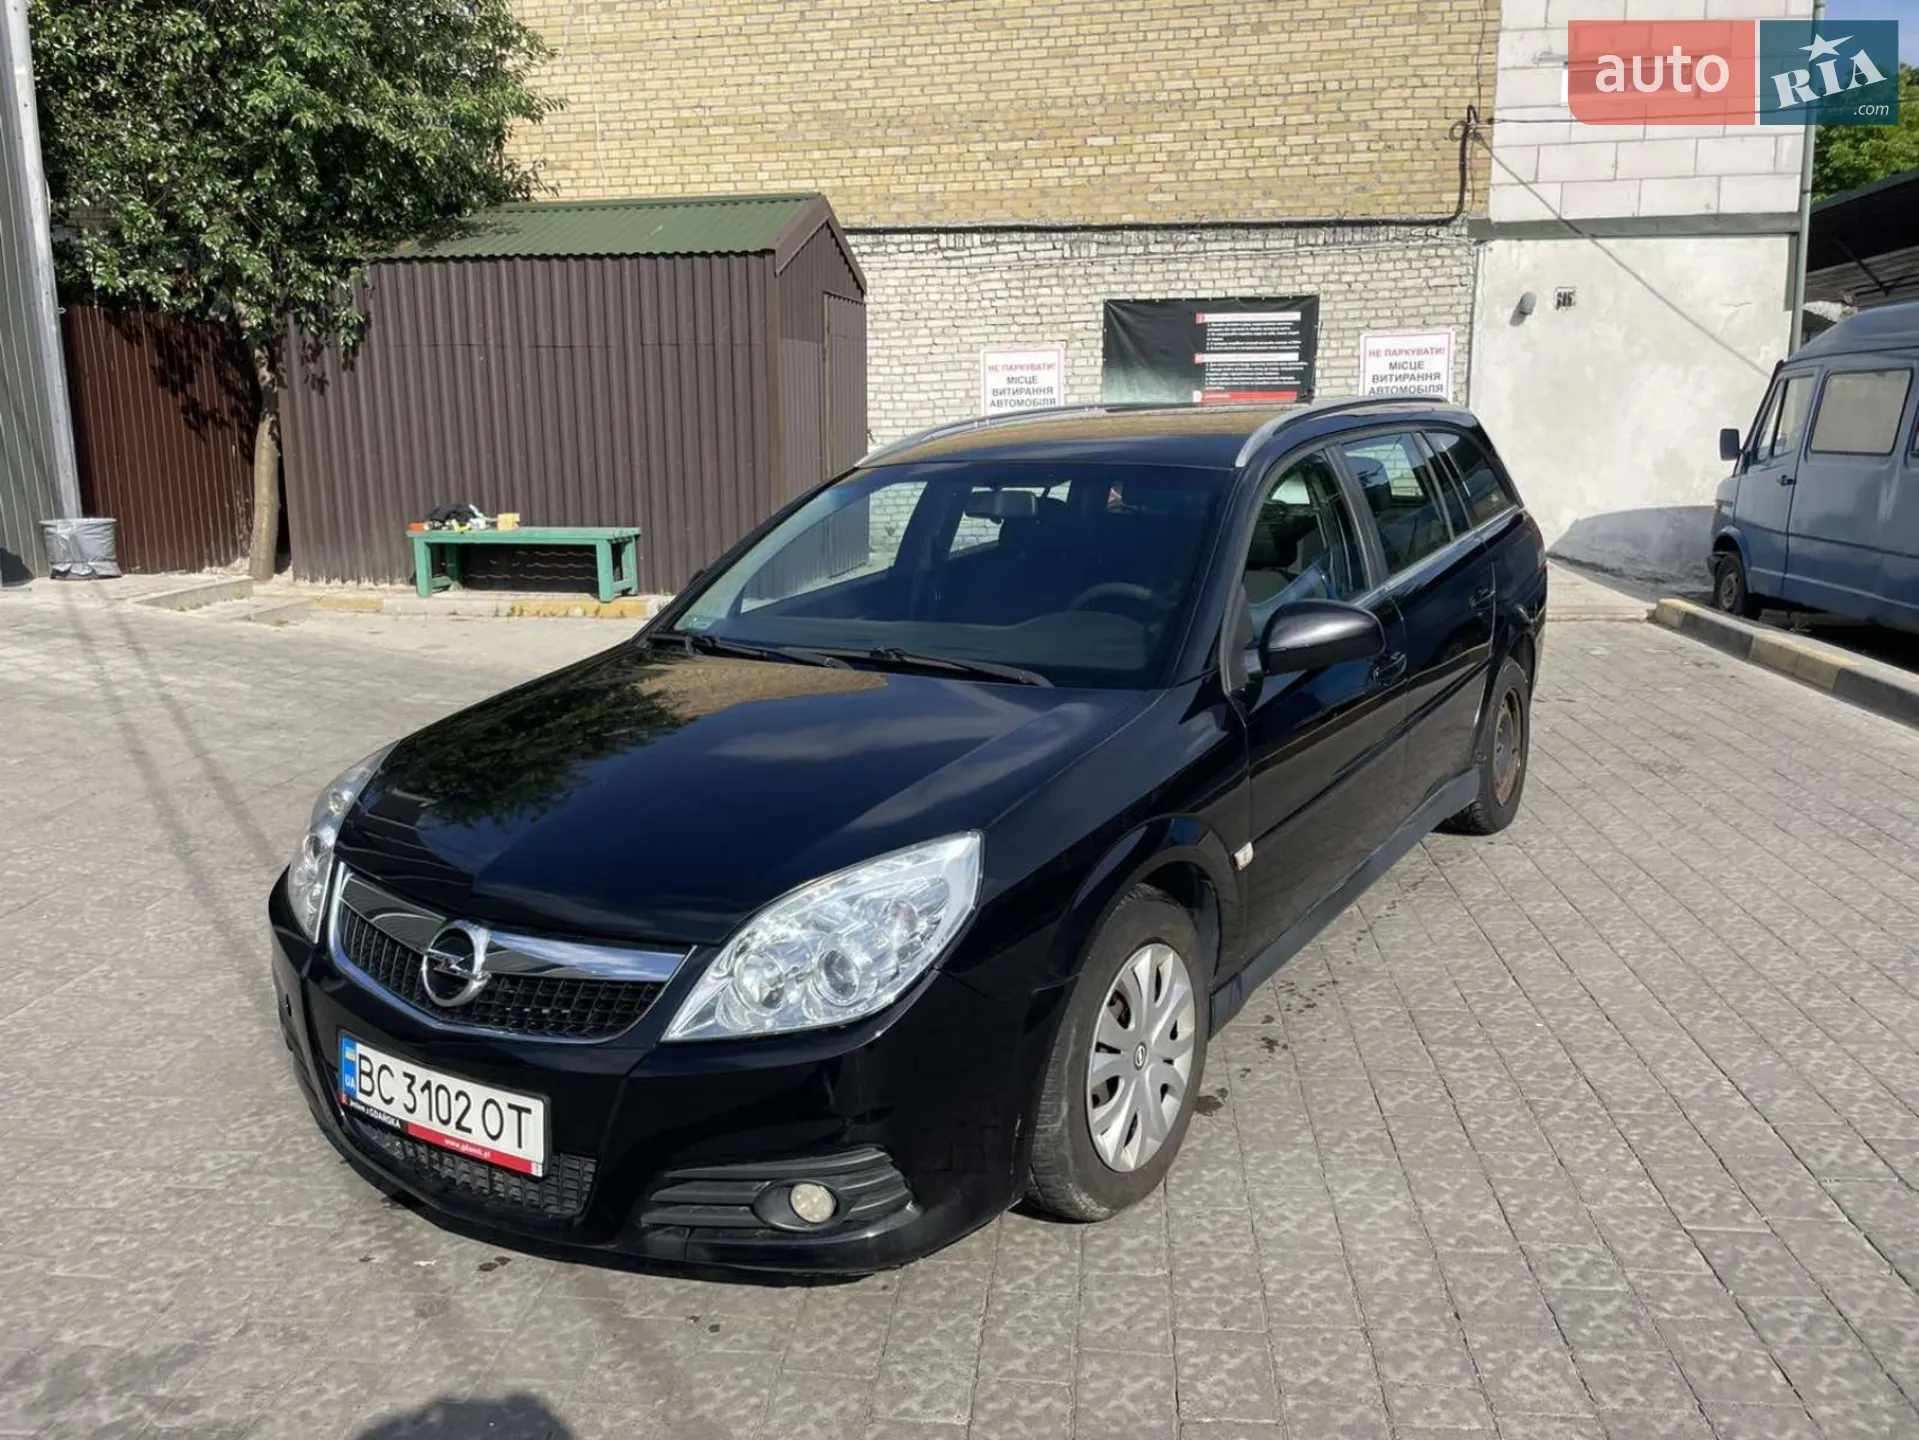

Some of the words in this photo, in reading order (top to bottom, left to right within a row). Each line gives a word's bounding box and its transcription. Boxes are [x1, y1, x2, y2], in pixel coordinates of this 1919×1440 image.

[1368, 348, 1382, 358] НЕ
[1384, 346, 1446, 357] ПАРКУВАТИ!
[987, 364, 1000, 373] НЕ
[1388, 360, 1426, 371] МІСЦЕ
[1006, 375, 1039, 385] МІСЦЕ
[1371, 372, 1442, 383] ВИТИРАННЯ
[991, 386, 1054, 397] ВИТИРАННЯ
[1368, 384, 1444, 396] АВТОМОБІЛЯ
[989, 397, 1057, 408] АВТОМОБІЛЯ
[344, 1074, 355, 1089] UA
[358, 1053, 395, 1105] BC
[402, 1071, 473, 1135] 3102
[481, 1098, 533, 1150] OT
